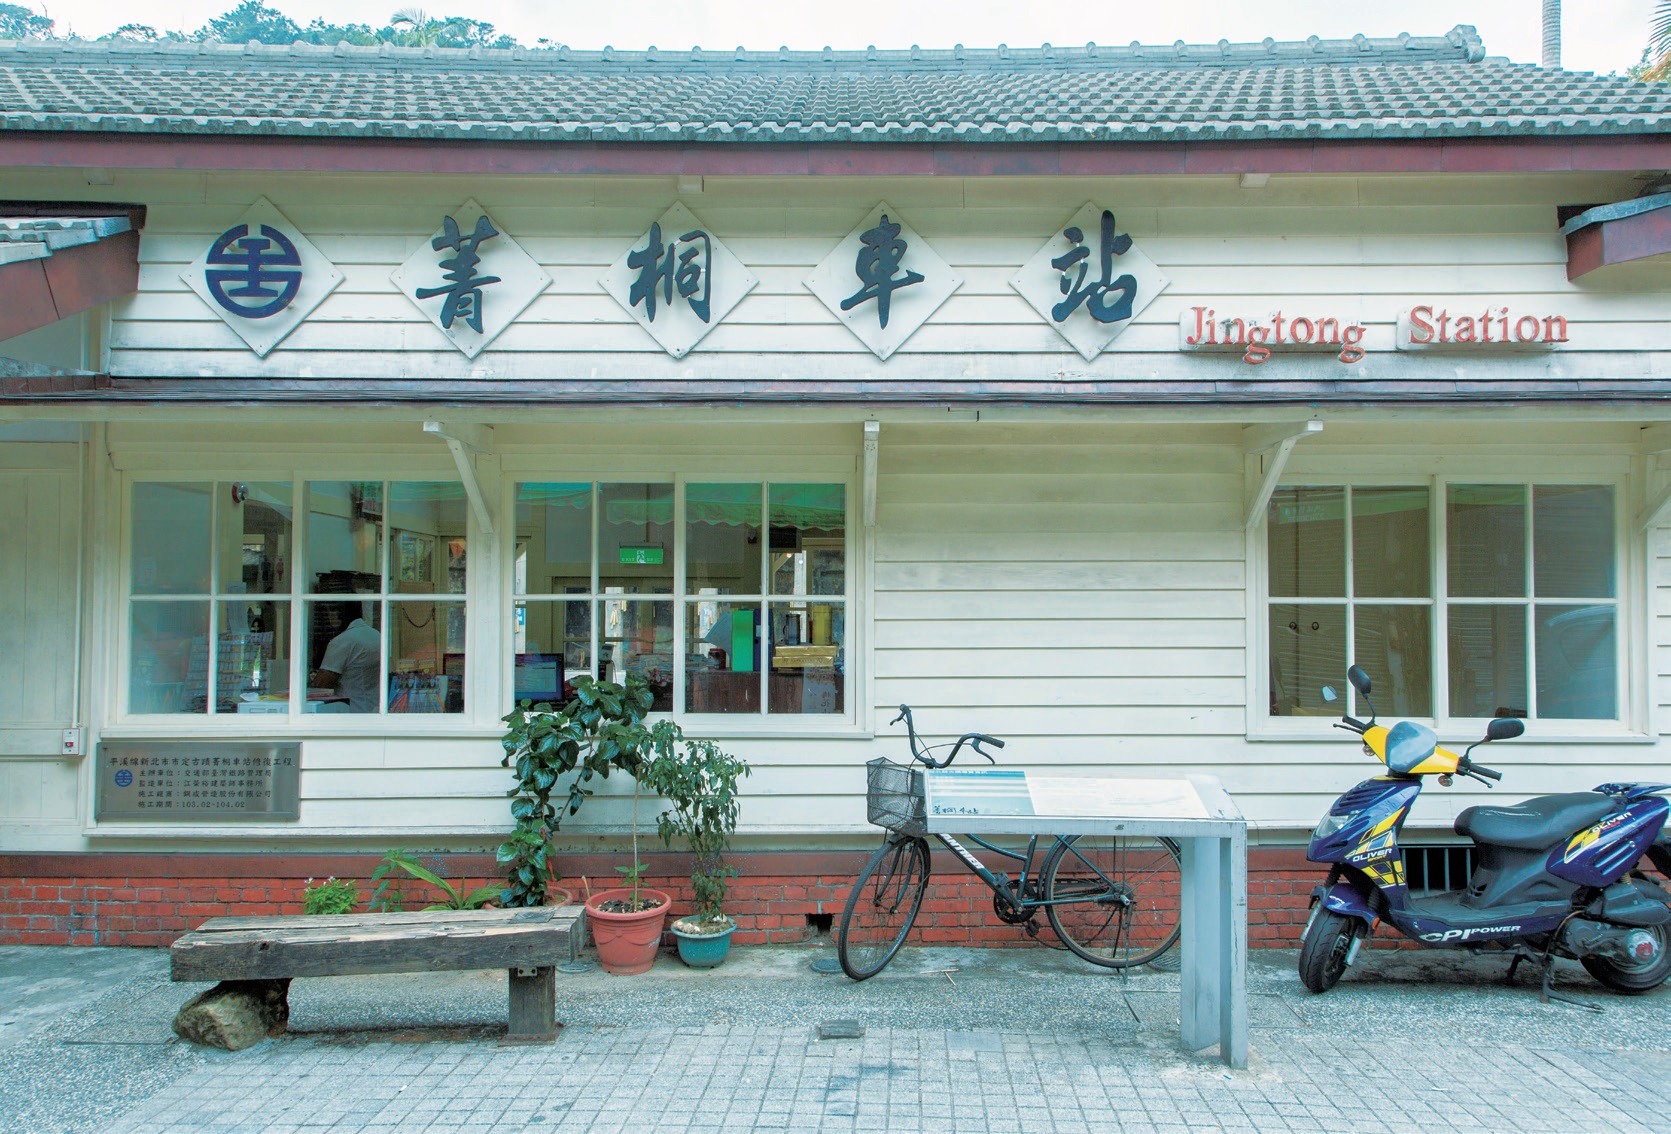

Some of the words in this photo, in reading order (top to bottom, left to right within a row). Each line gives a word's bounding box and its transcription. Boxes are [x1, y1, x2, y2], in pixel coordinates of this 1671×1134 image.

[415, 209, 1138, 334] 菁桐車站
[1187, 305, 1367, 365] Jingtong
[1410, 305, 1570, 344] Station
[1591, 811, 1632, 832] OLIVER
[939, 833, 985, 869] ANTHER
[1353, 847, 1393, 863] OLIVER
[1469, 925, 1521, 935] POWER
